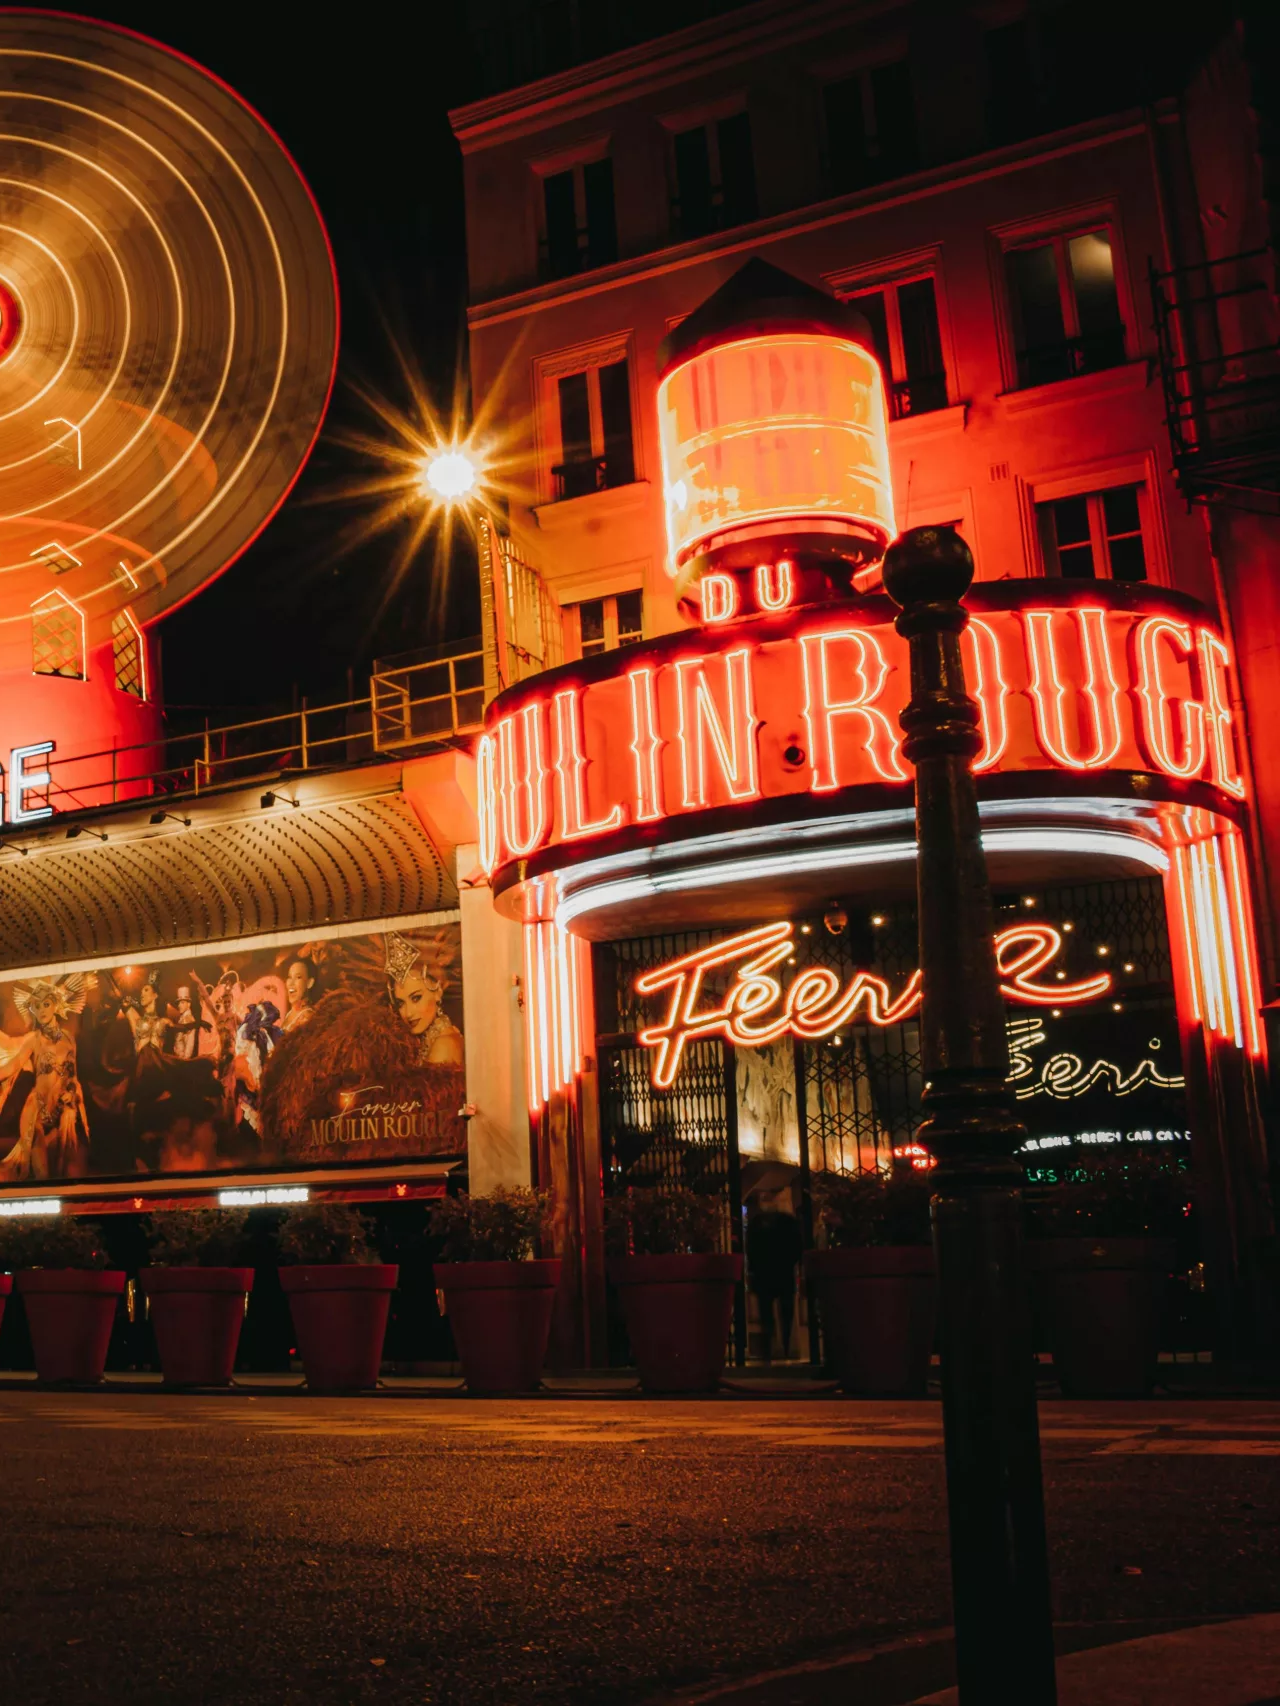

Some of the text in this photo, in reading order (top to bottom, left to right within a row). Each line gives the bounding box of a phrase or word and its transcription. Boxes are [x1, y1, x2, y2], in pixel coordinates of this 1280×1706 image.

[700, 560, 796, 622] DU
[477, 648, 759, 875] OULIN
[637, 920, 1112, 1089] Féere
[311, 1116, 379, 1147] MOULIN
[329, 1085, 423, 1128] Forever
